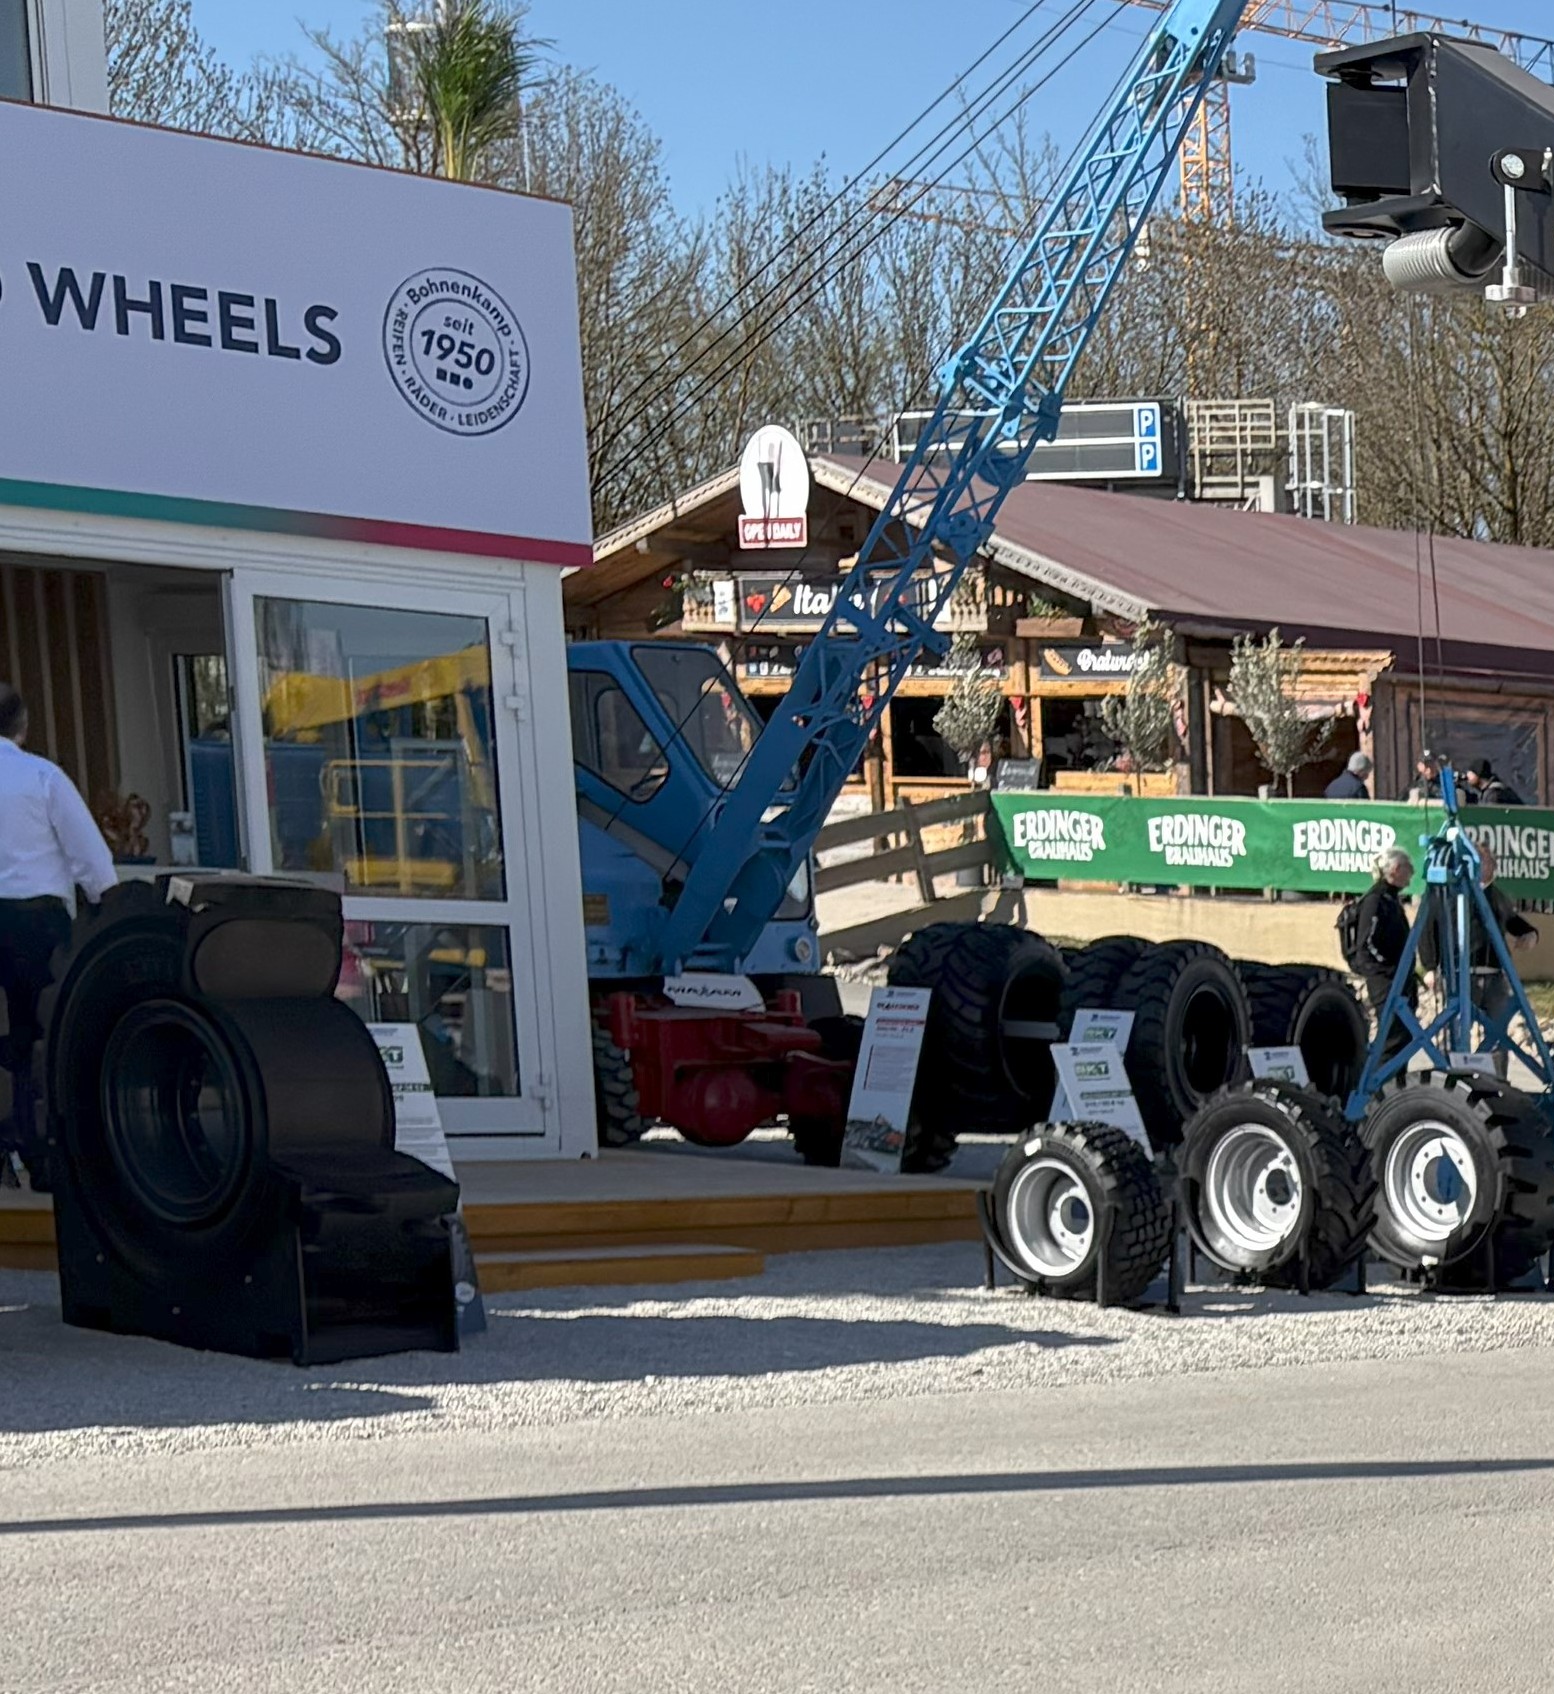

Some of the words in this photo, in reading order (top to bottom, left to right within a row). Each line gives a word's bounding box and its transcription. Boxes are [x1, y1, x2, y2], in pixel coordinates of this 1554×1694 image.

[26, 261, 342, 366] WHEELS
[406, 278, 512, 337] Bohnenkamp
[443, 315, 475, 336] seit
[392, 307, 408, 366] REIFEN
[404, 376, 448, 421] RÄDER
[458, 348, 521, 426] LEIDENSCHAFT
[421, 328, 495, 376] 1950
[1141, 410, 1153, 436] P
[1142, 443, 1155, 469] P
[1013, 809, 1106, 851] ERDINGER
[1147, 814, 1247, 857] ERDINGER
[1292, 818, 1397, 858] ERDINGER
[1028, 841, 1093, 862] BRAUHAUS
[1164, 846, 1235, 868] BRAUHAUS
[1309, 851, 1375, 873] BRAUHAU
